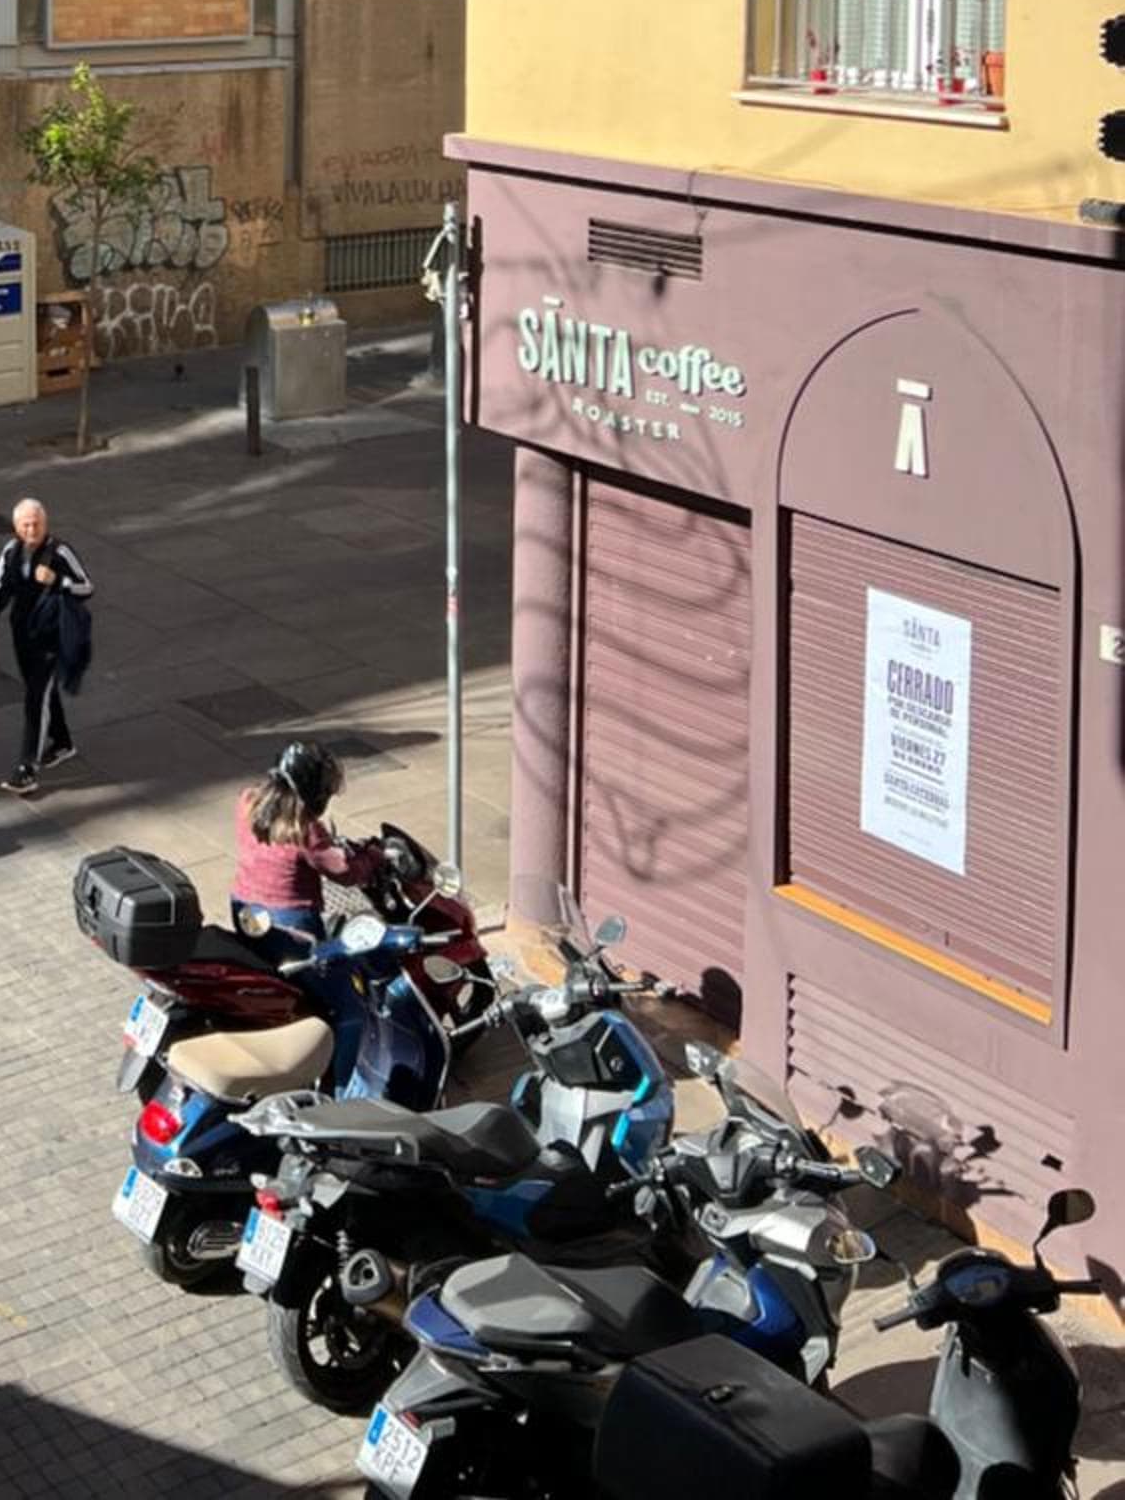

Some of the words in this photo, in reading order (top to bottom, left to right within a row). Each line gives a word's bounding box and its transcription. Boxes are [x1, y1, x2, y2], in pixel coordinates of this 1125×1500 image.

[638, 344, 745, 395] coffee
[572, 398, 680, 439] ROASTER
[887, 659, 954, 715] CERRADO
